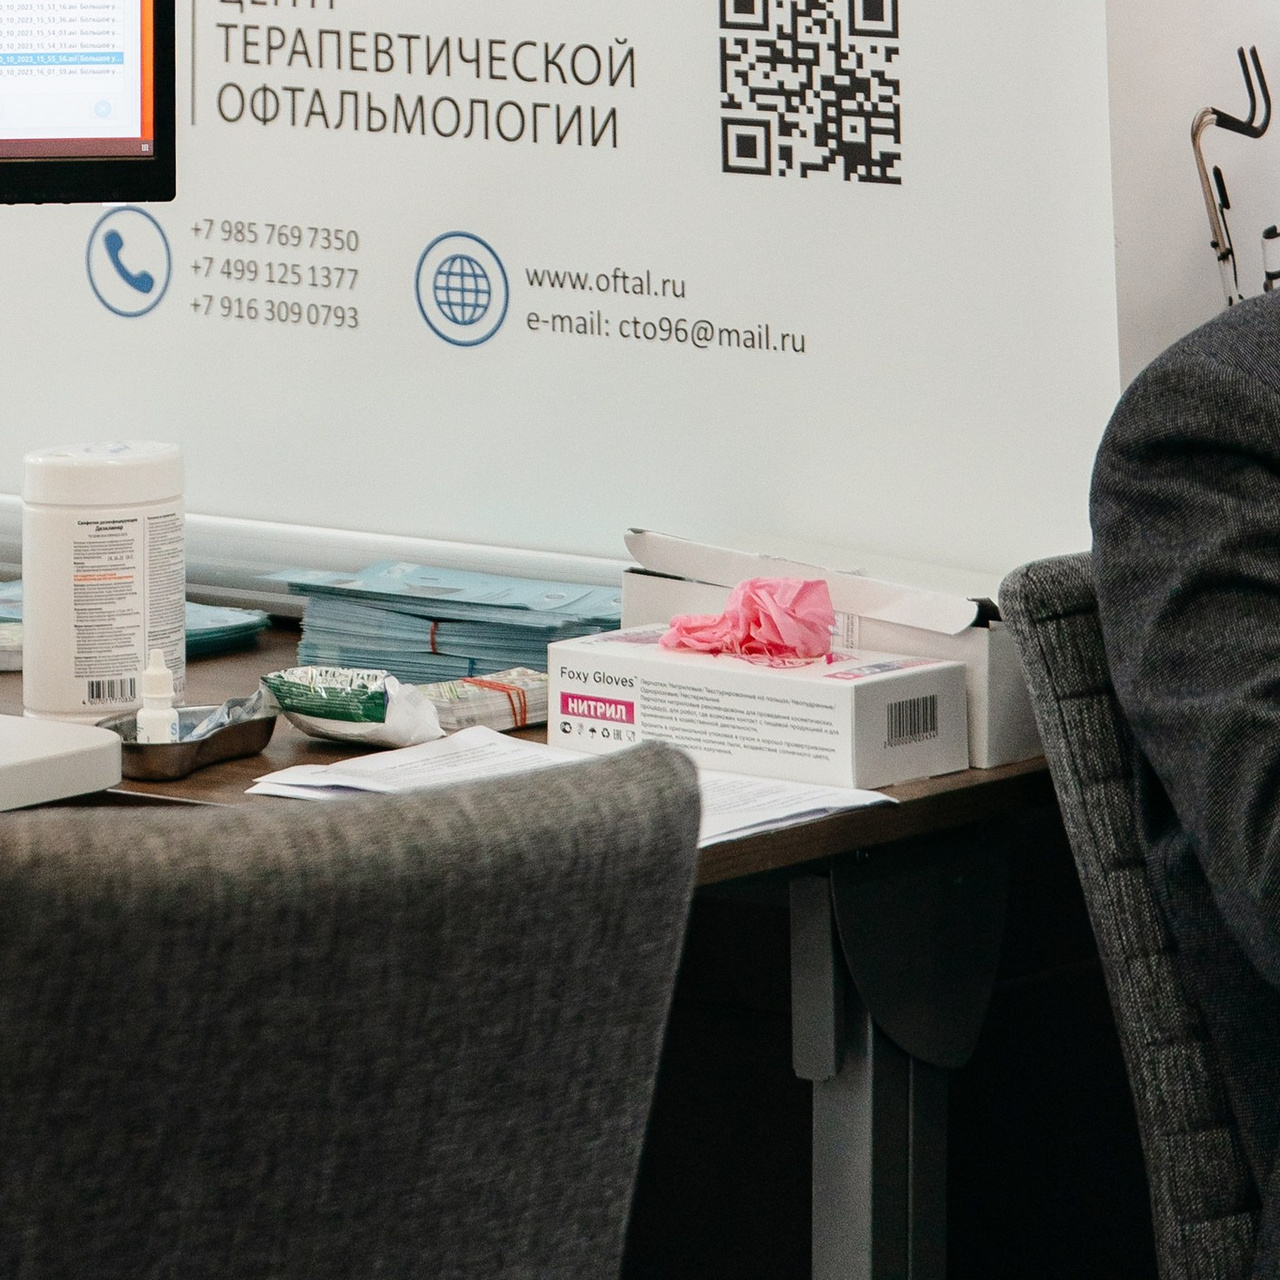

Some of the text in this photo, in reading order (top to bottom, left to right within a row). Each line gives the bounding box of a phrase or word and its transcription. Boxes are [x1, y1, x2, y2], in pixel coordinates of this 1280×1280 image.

[215, 22, 638, 90] ТЕРАПЕВТИЧЕСКОЙ
[215, 80, 620, 149] ОФТАЛЬМОЛОГИИ
[190, 219, 360, 254] +7 985 769 7350
[190, 257, 360, 293] +7 499 125 1377
[524, 263, 687, 300] www.oftal.ru
[190, 295, 360, 331] +7 916 309 0793
[525, 307, 807, 355] e-mail: cto96@mail.ru
[560, 666, 590, 684] Foxy
[567, 697, 627, 722] НИТРИЛ
